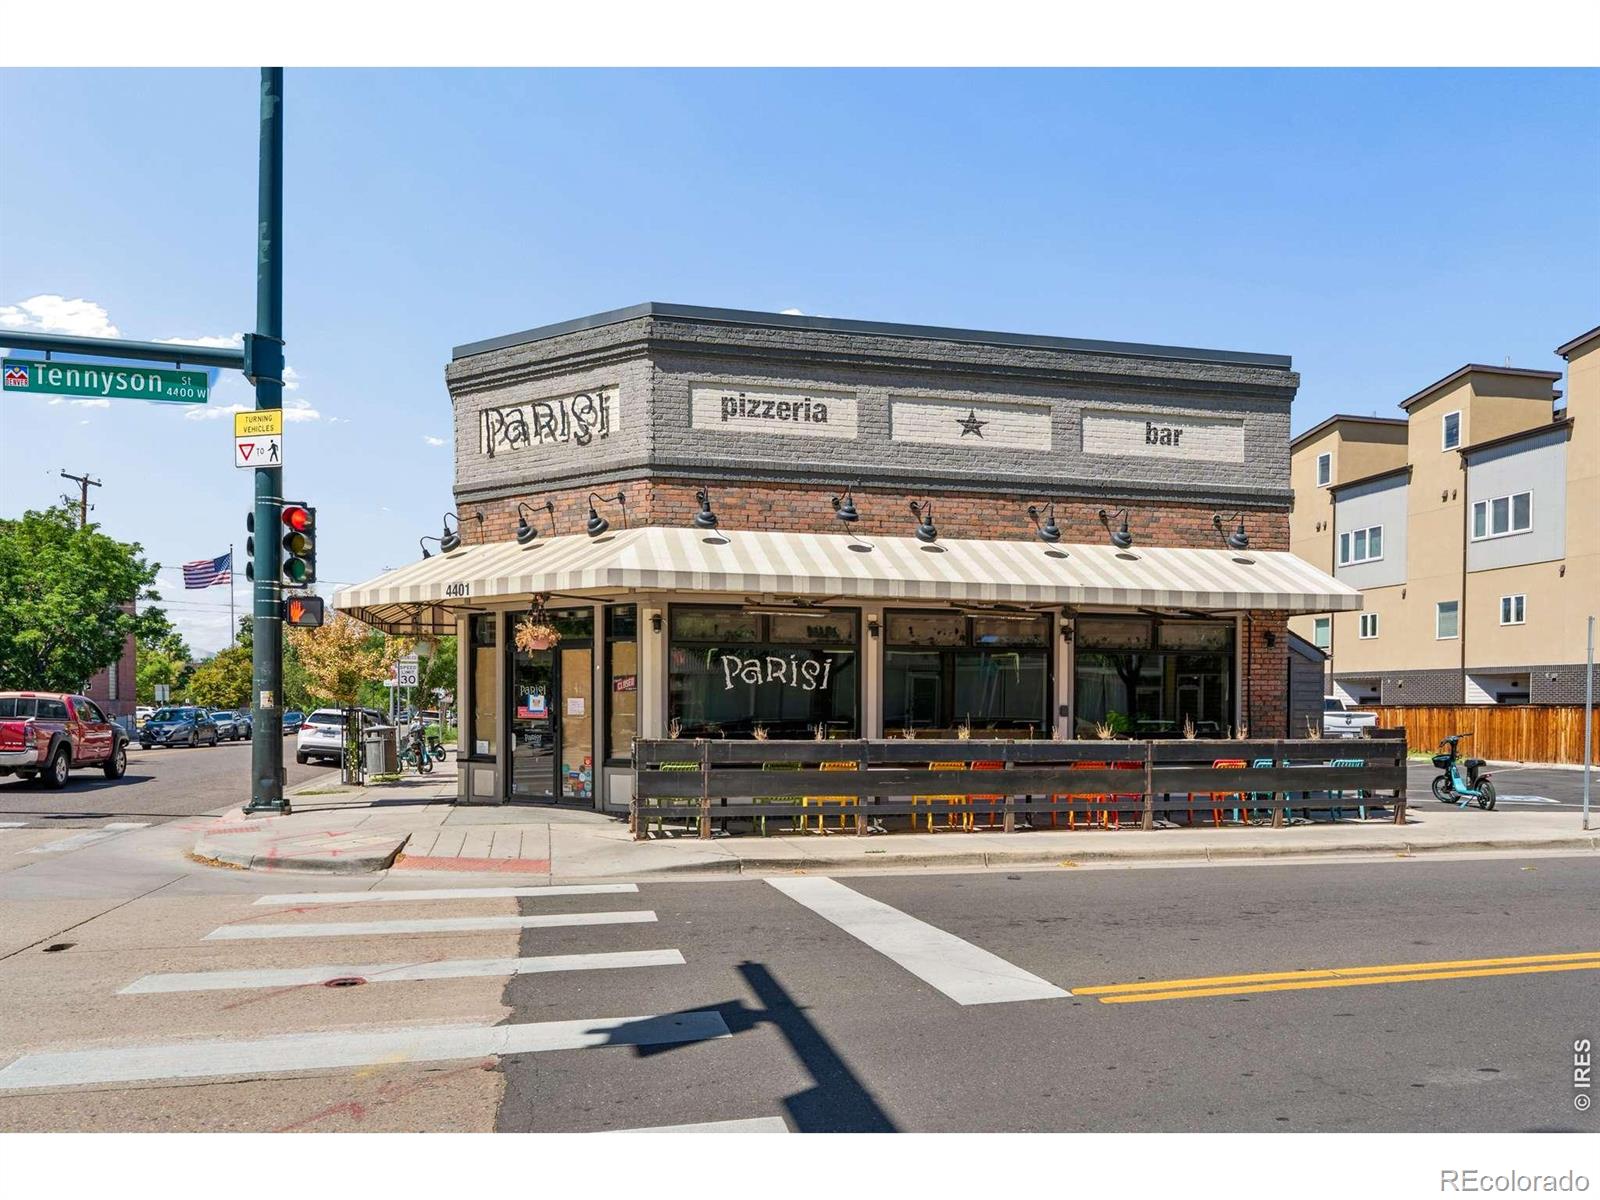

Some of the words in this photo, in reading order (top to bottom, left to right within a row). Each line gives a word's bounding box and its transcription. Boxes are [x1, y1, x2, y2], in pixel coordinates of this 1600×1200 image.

[34, 363, 162, 394] Tennyson
[181, 376, 192, 386] St
[167, 387, 193, 398] 4400
[197, 389, 206, 398] W
[721, 393, 828, 422] pizzeria
[245, 415, 273, 423] TURNING
[243, 425, 274, 433] VEHICLES
[1145, 422, 1183, 446] bar
[256, 448, 265, 456] TO
[446, 583, 470, 597] 4401
[401, 675, 416, 685] 30
